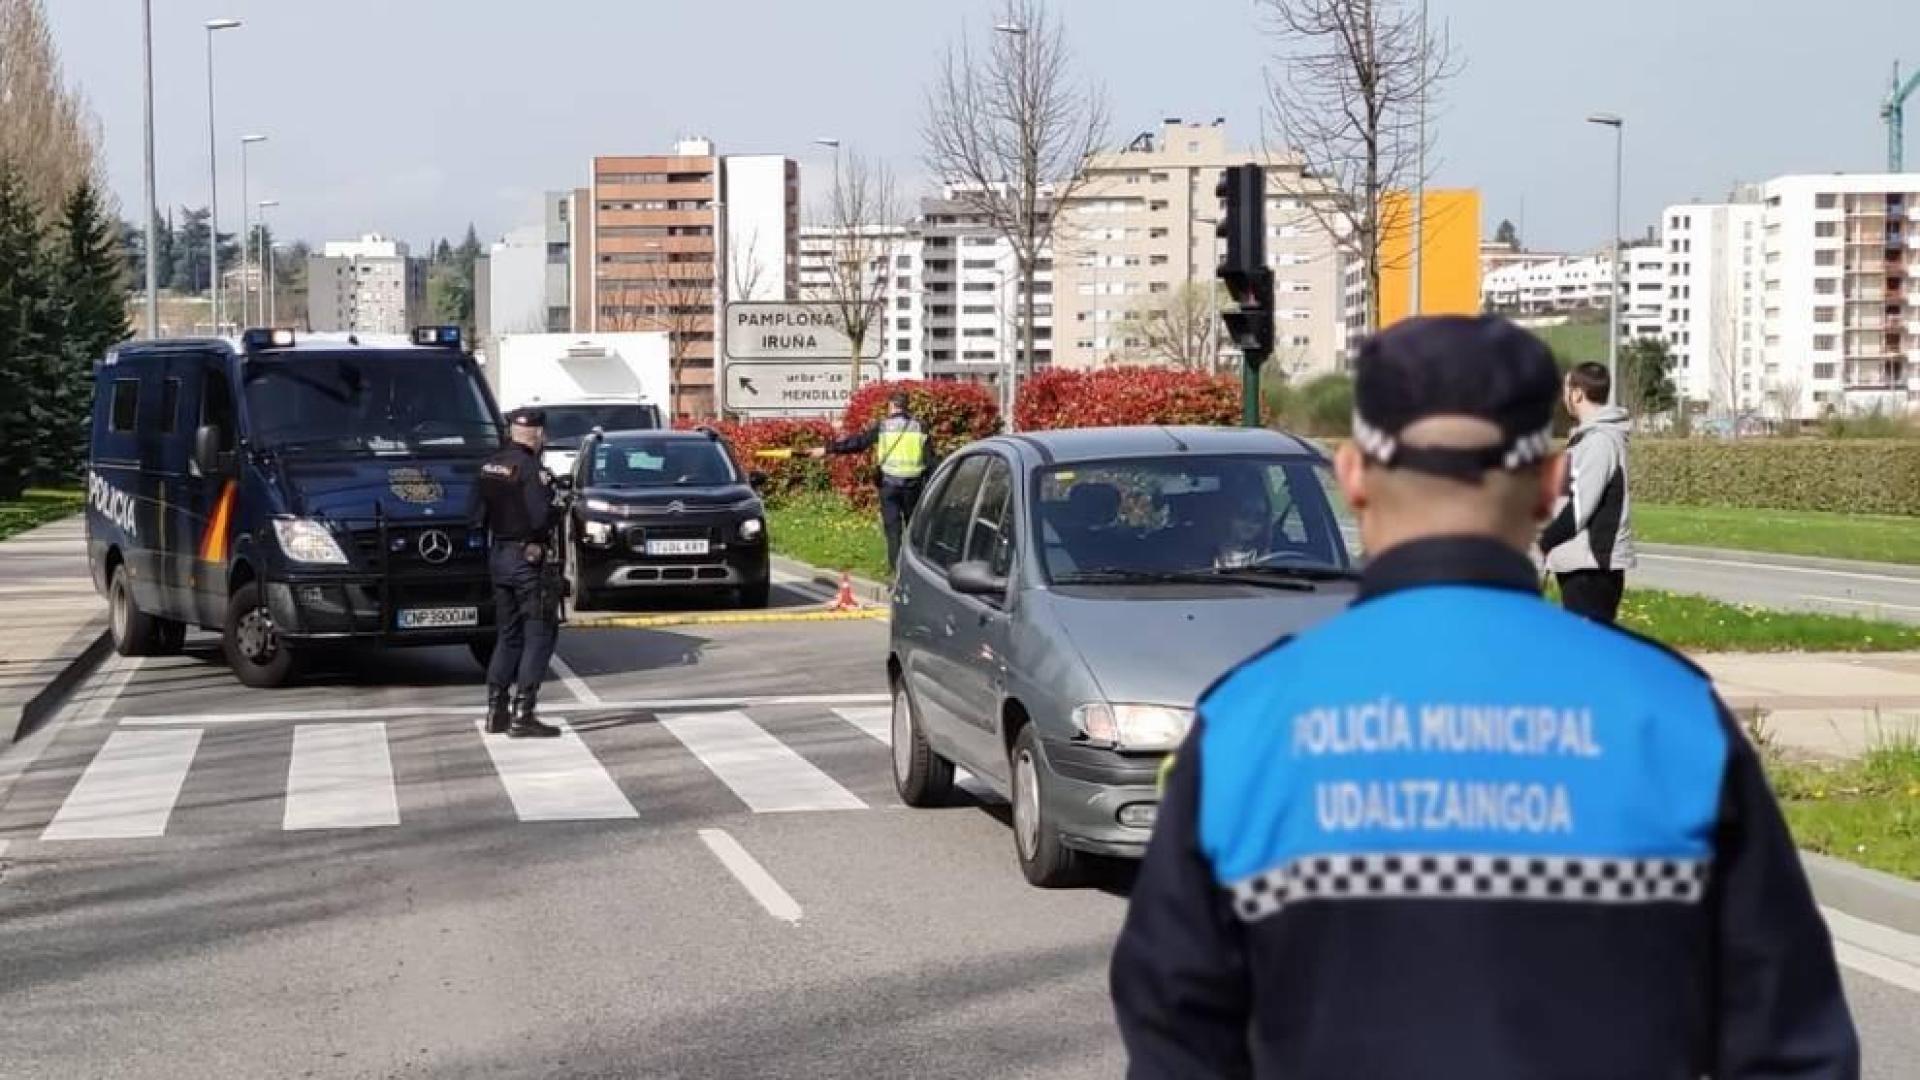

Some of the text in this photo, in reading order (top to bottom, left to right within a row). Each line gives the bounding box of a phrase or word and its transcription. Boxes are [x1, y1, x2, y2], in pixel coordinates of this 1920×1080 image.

[782, 389, 850, 401] MENDILLO
[88, 470, 137, 537] POLICIA
[1419, 702, 1602, 757] MUNICIPAL
[1316, 780, 1573, 832] UDALTZAINGOA
